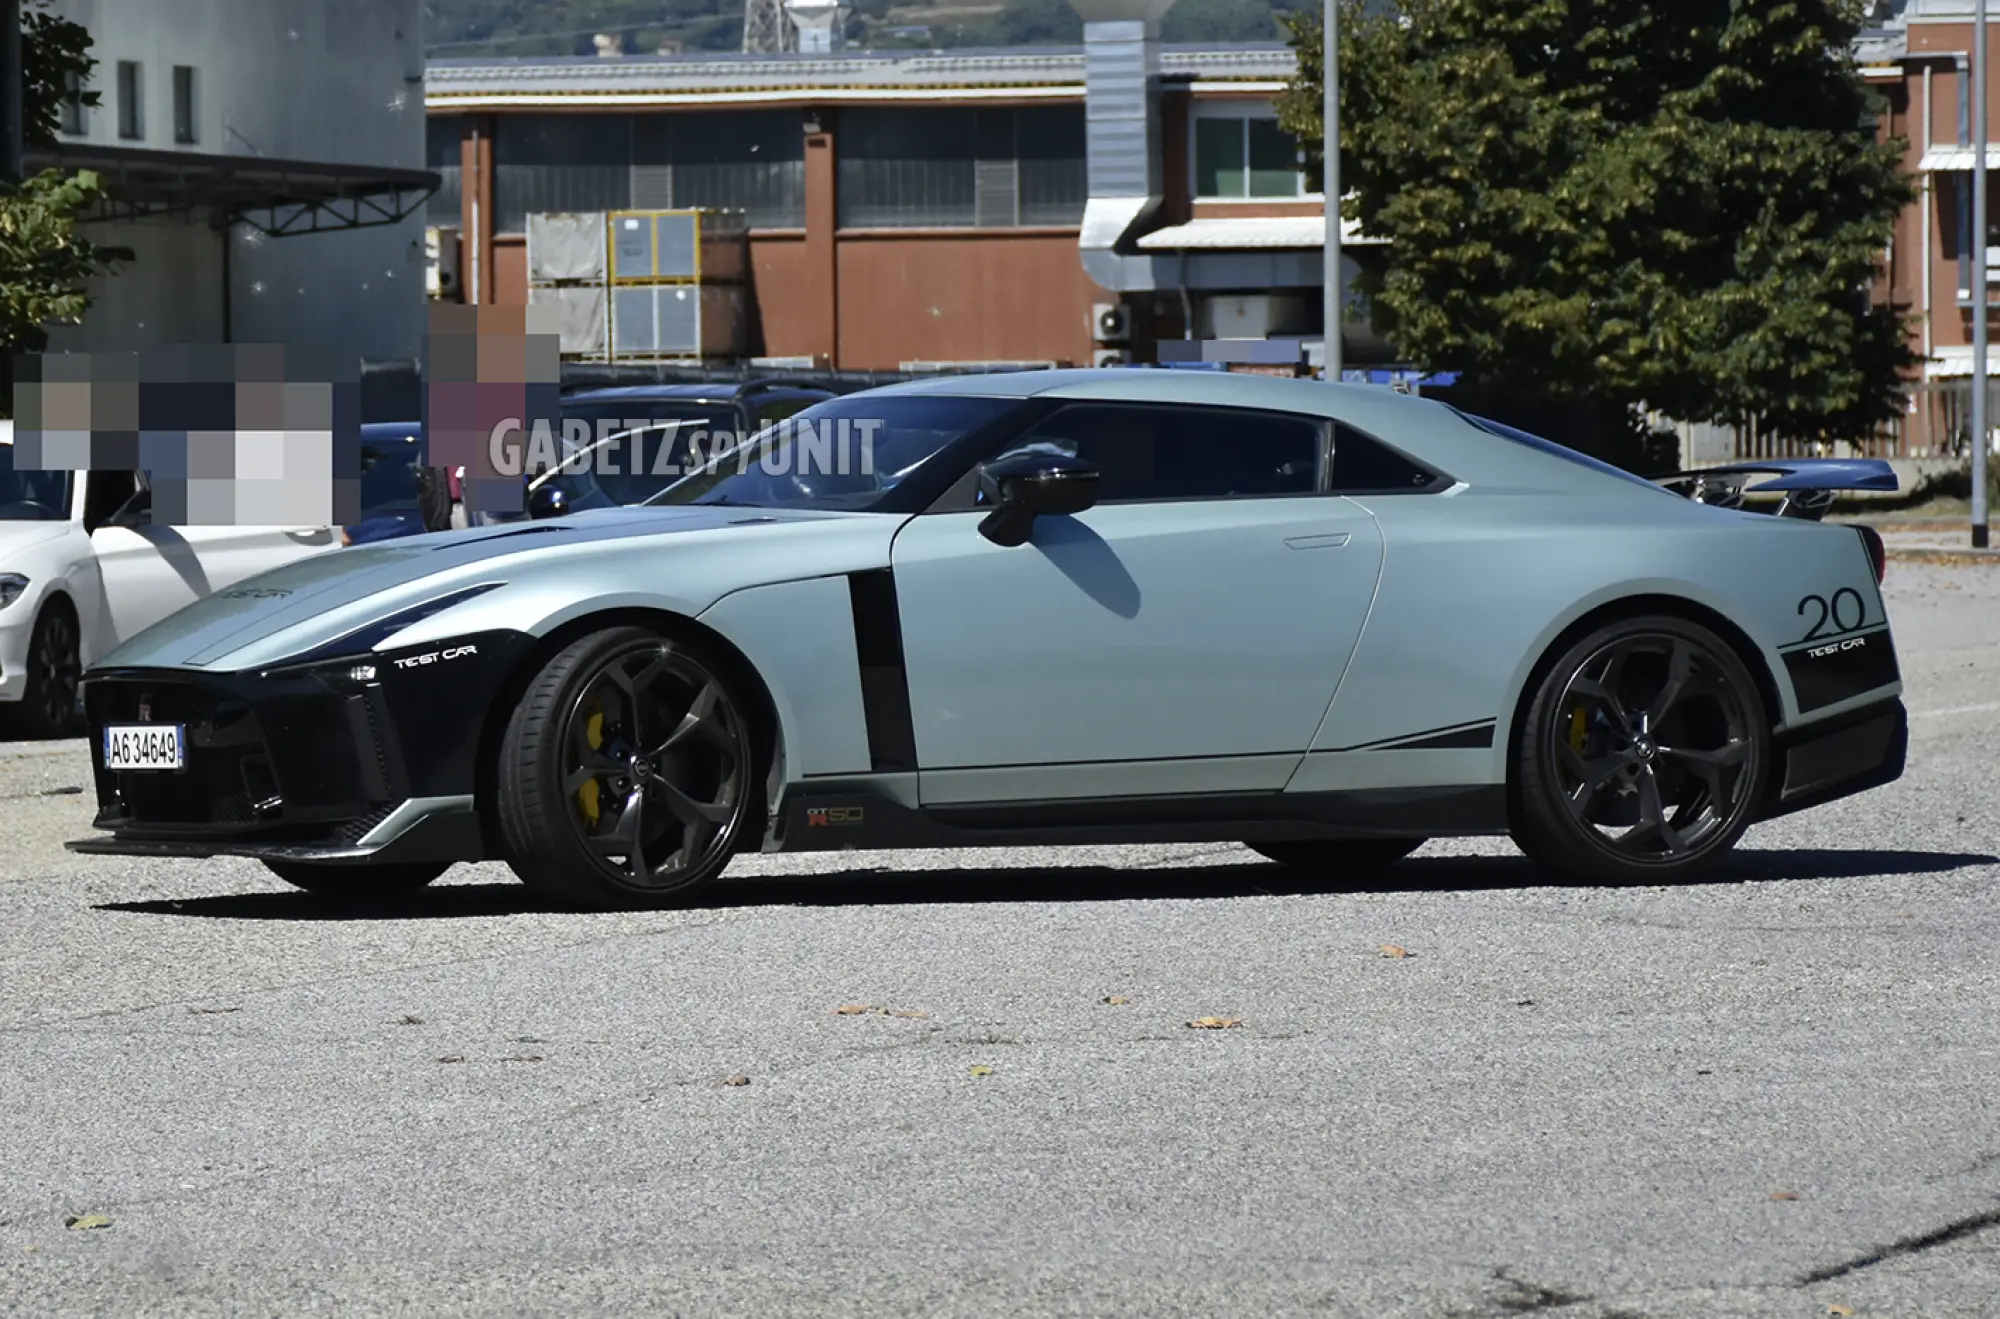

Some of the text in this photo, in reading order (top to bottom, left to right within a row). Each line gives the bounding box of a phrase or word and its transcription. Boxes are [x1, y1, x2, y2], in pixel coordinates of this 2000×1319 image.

[1798, 587, 1865, 642] 20
[393, 645, 477, 669] TEST CAR
[1807, 638, 1865, 658] TEST CAR
